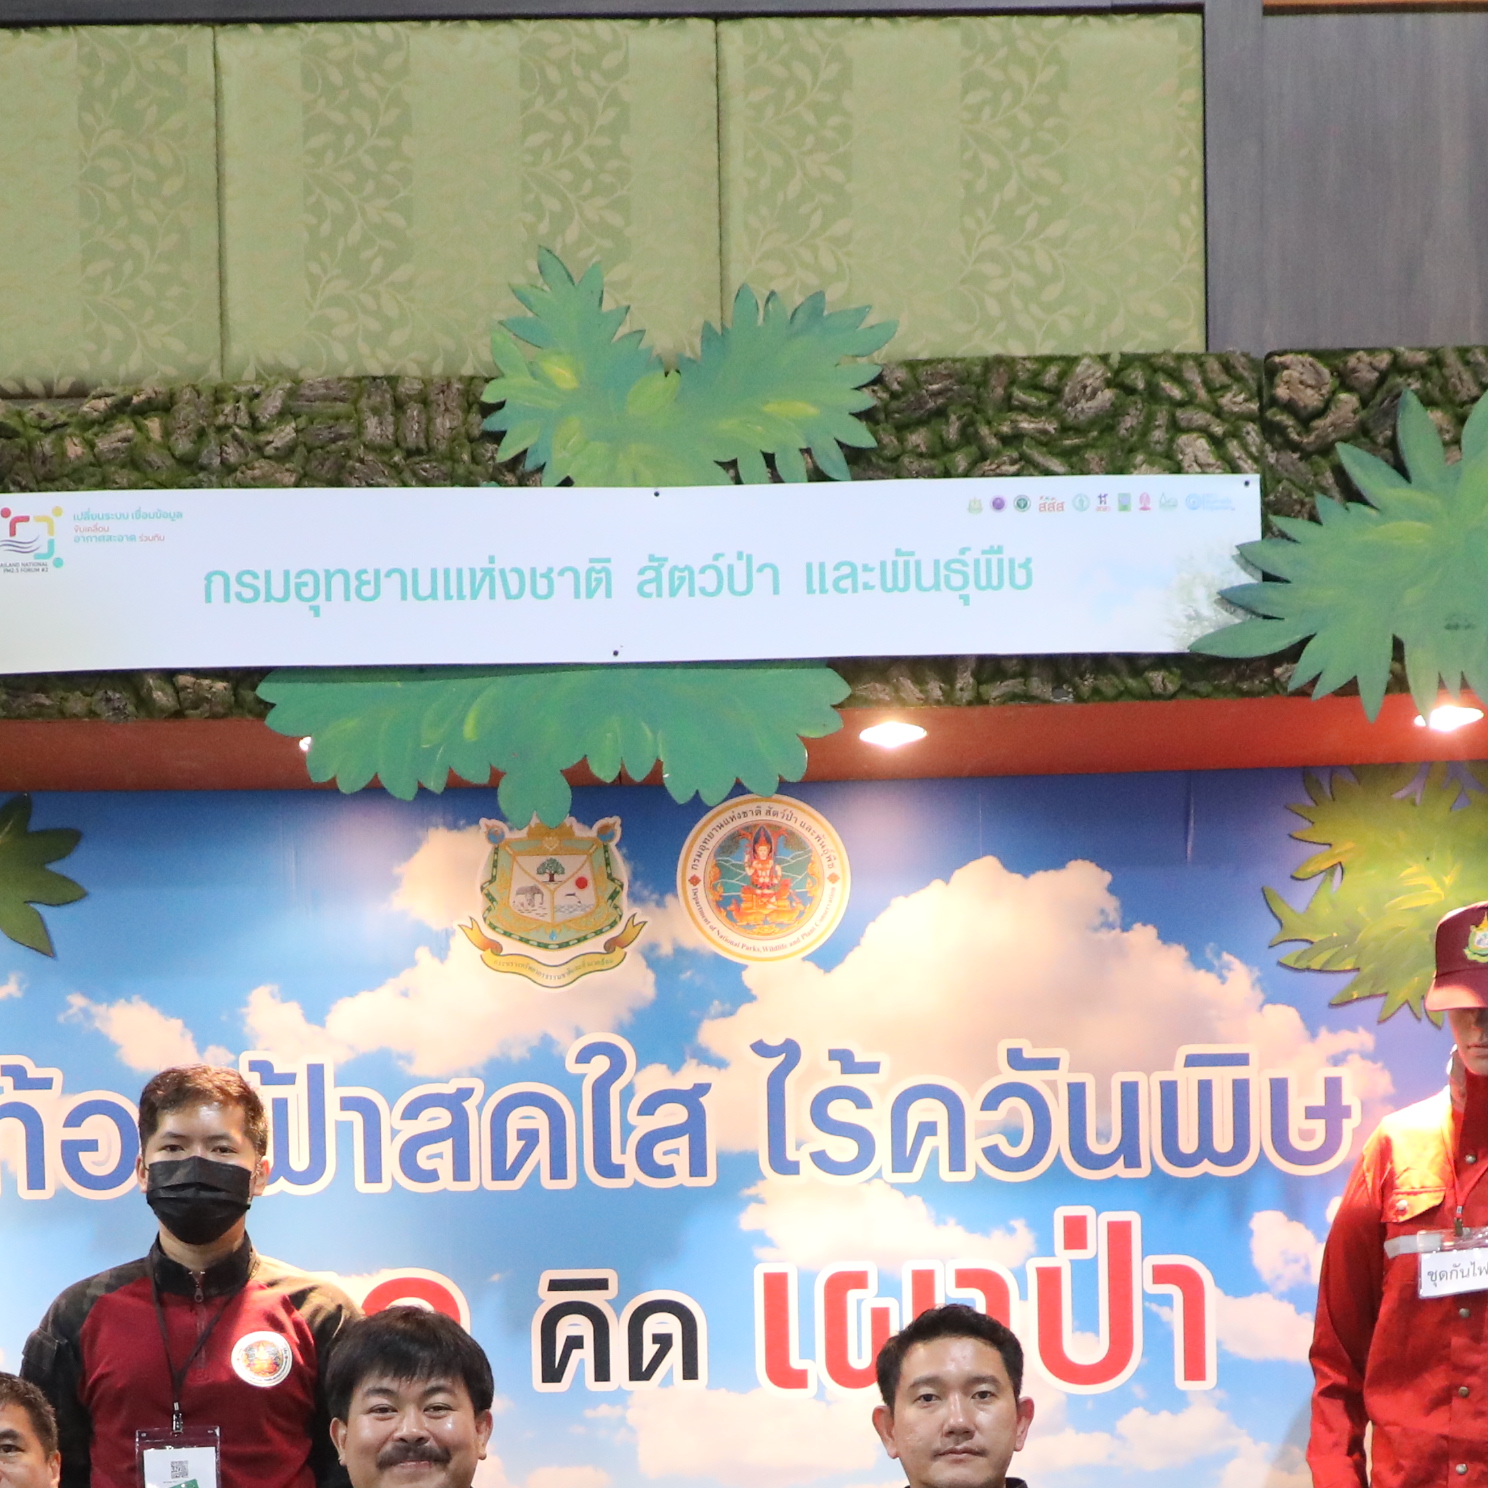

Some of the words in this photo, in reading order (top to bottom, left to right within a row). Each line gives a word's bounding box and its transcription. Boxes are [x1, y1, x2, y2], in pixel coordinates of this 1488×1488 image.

[204, 555, 614, 618] กรมอุทยานแห่งชาติ
[636, 552, 780, 599] สัตว์ป่า
[805, 546, 1034, 607] และพันธุ์พืช
[749, 1036, 1354, 1177] ไร้ควันพิษ
[540, 1277, 700, 1384] คิด
